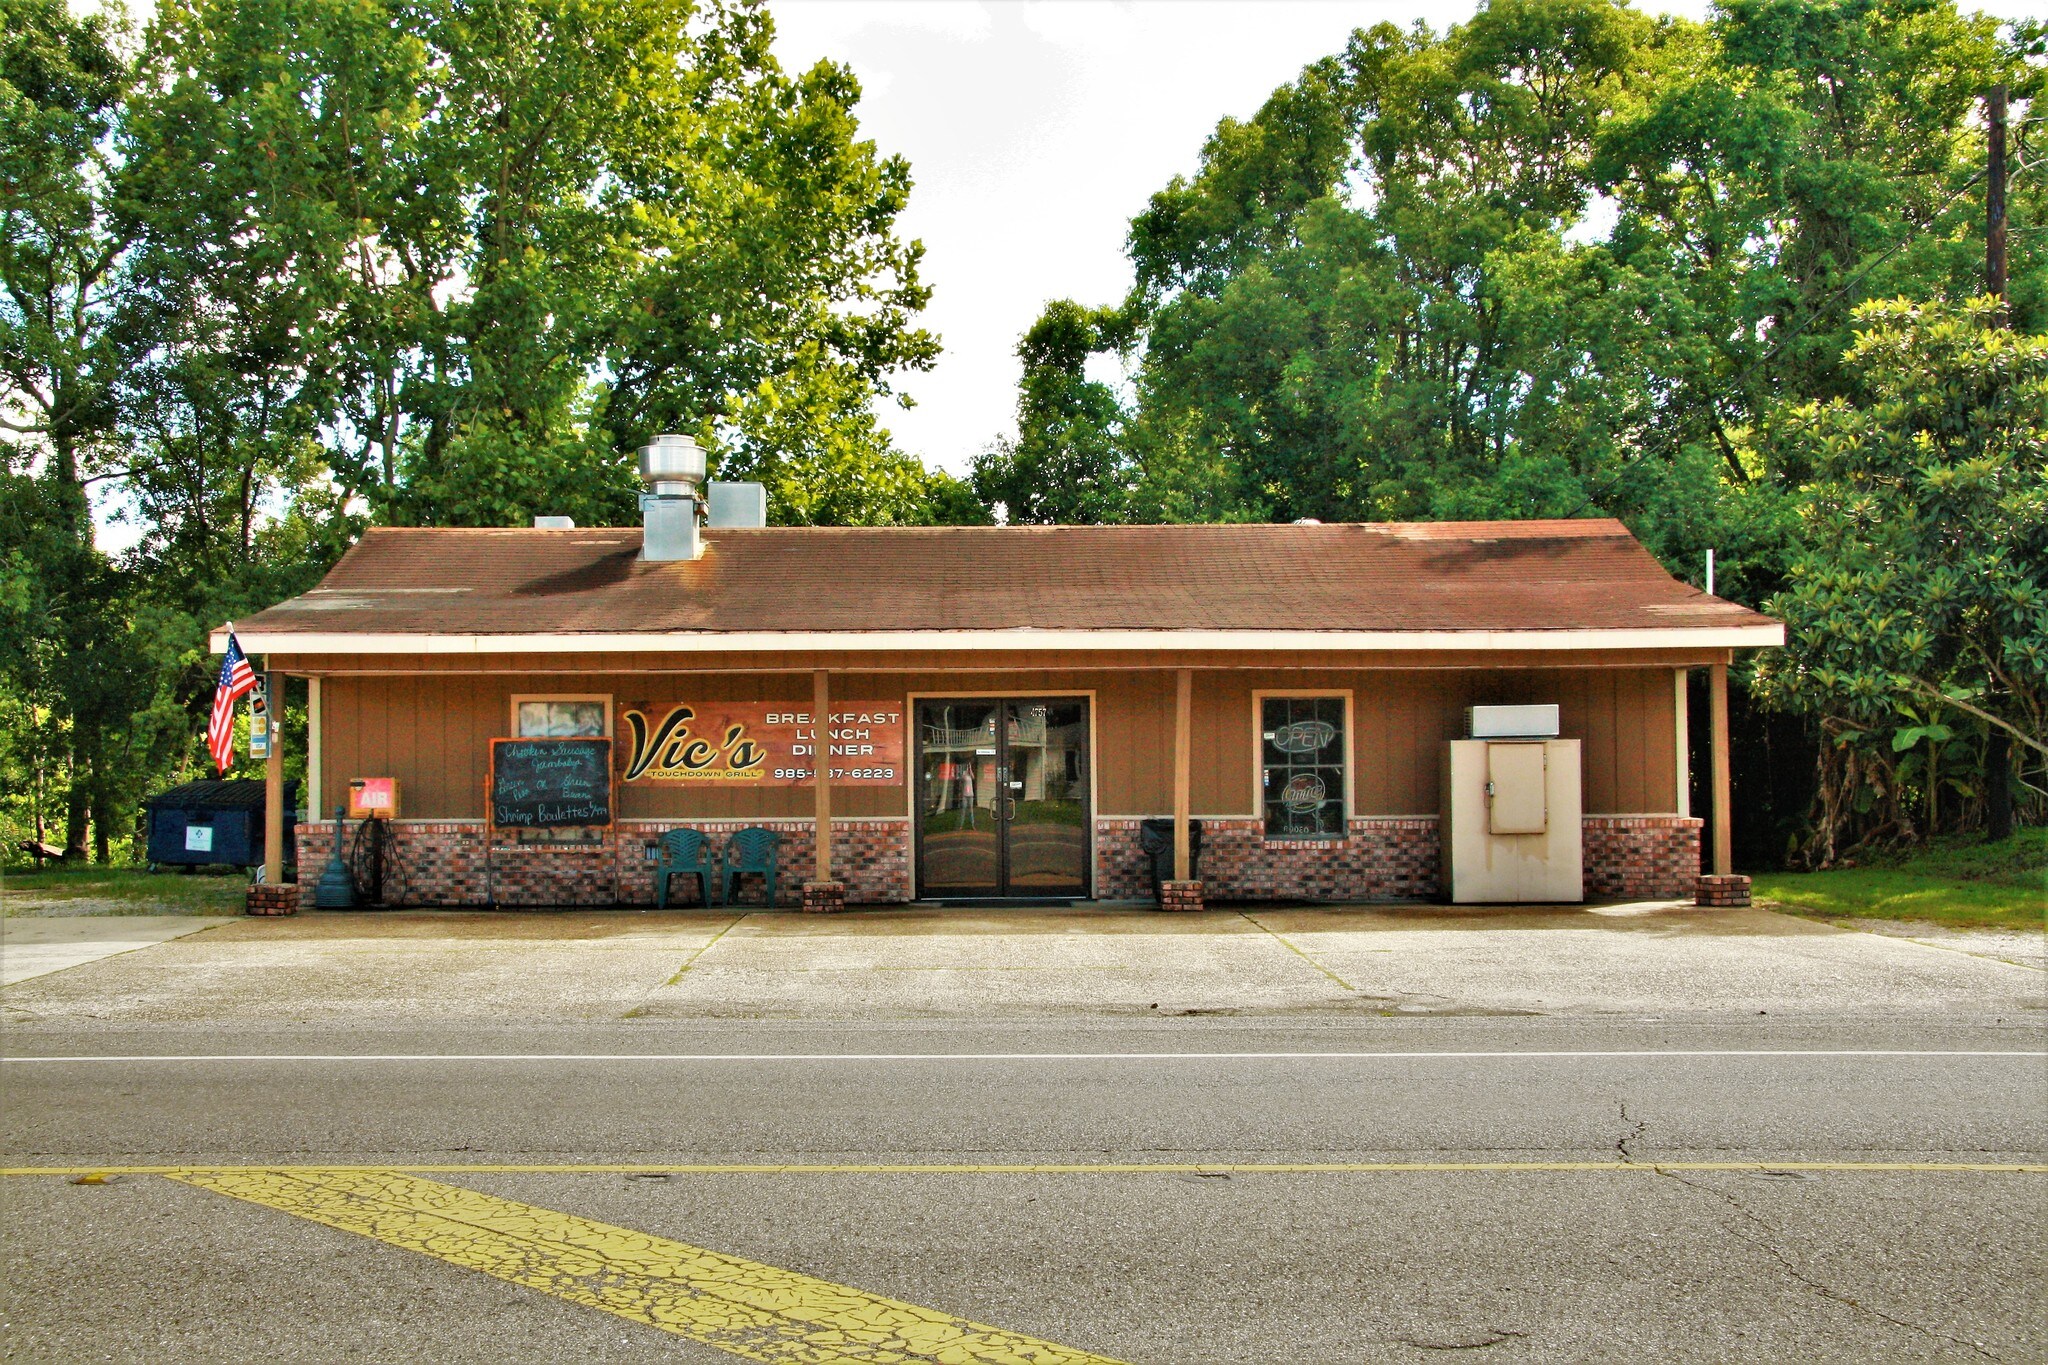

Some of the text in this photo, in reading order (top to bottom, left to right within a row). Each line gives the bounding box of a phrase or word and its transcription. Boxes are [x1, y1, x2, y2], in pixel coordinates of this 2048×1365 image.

[766, 713, 900, 724] BREKFAST
[624, 706, 766, 781] Vic's
[1275, 726, 1329, 748] OPEN
[792, 745, 874, 756] DINER
[774, 768, 894, 779] 985-7-6223
[361, 791, 389, 806] AIR
[497, 805, 533, 825] Shrimp
[538, 803, 589, 822] Boulettes
